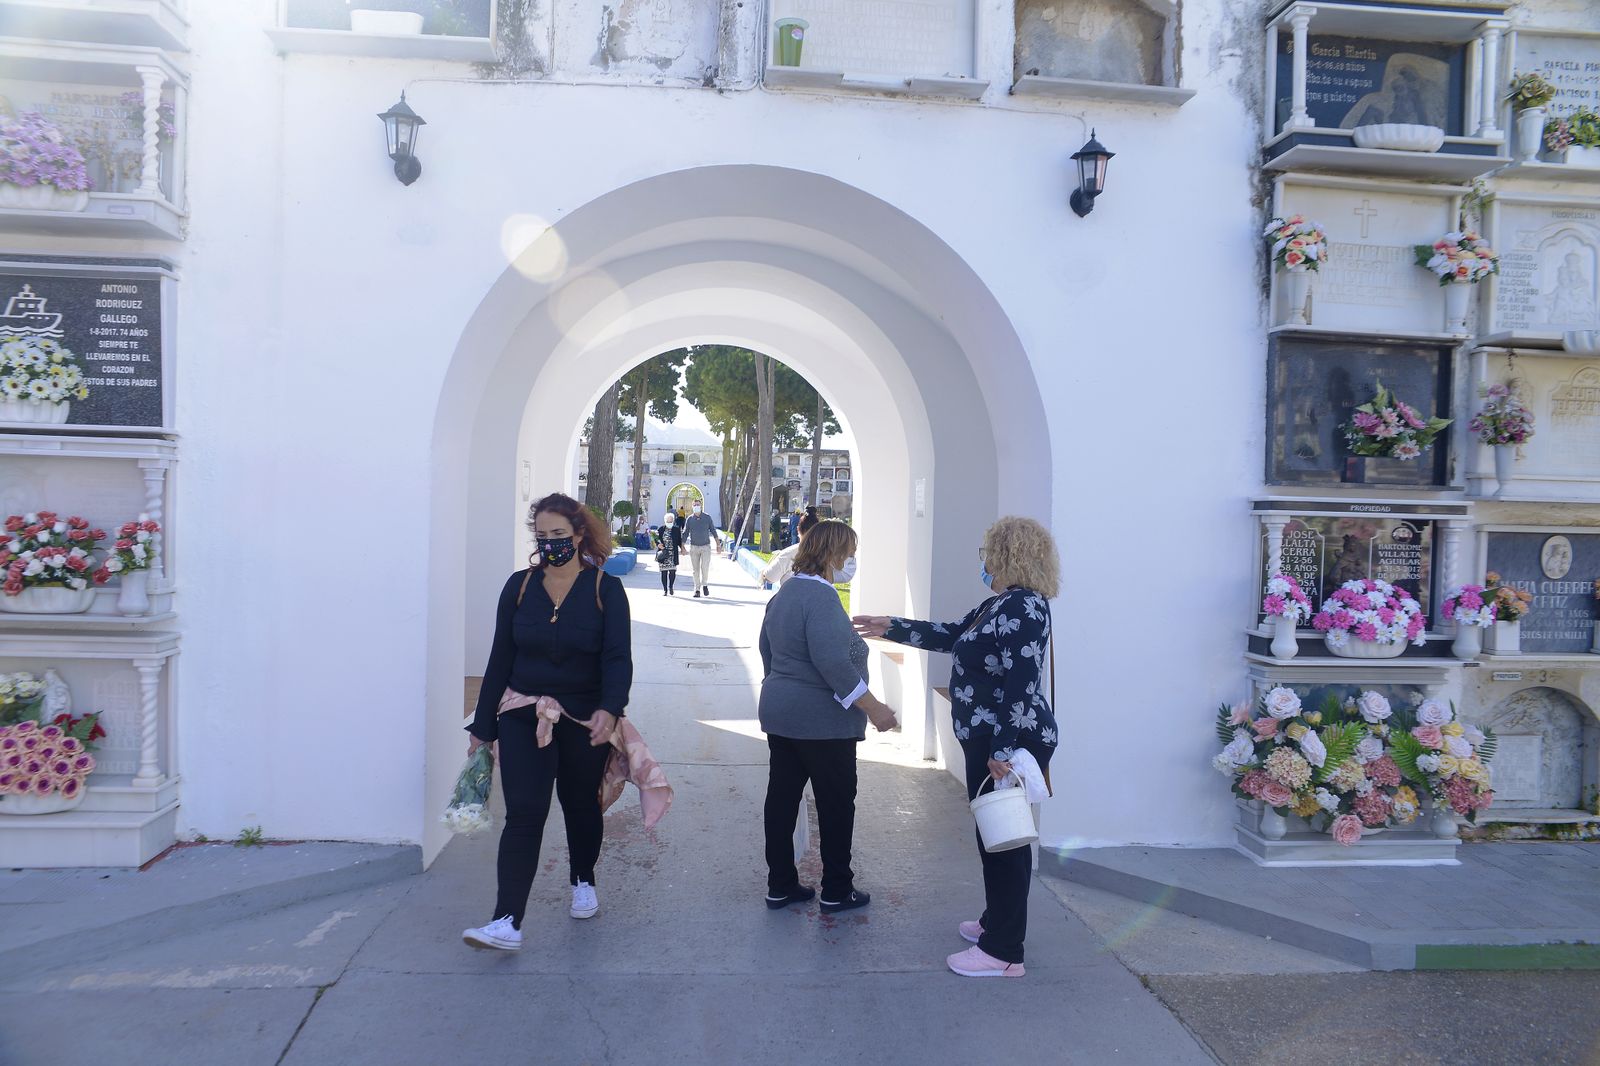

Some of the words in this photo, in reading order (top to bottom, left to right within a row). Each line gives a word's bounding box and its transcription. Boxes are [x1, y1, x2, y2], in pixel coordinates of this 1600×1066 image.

[1555, 89, 1590, 98] ANCISCO
[101, 284, 138, 294] ANTONIO
[96, 299, 142, 309] RODRIGUEZ
[100, 314, 138, 324] GALLEGO
[129, 328, 148, 336] AÑOS
[98, 340, 128, 348] SIEMPRE
[86, 353, 130, 361] LLEVAREMOS
[83, 377, 105, 385] ESTOS
[1288, 530, 1314, 539] JOSE
[1294, 563, 1318, 572] AÑOS
[1555, 631, 1586, 640] FAMILIA
[1539, 670, 1547, 682] 3
